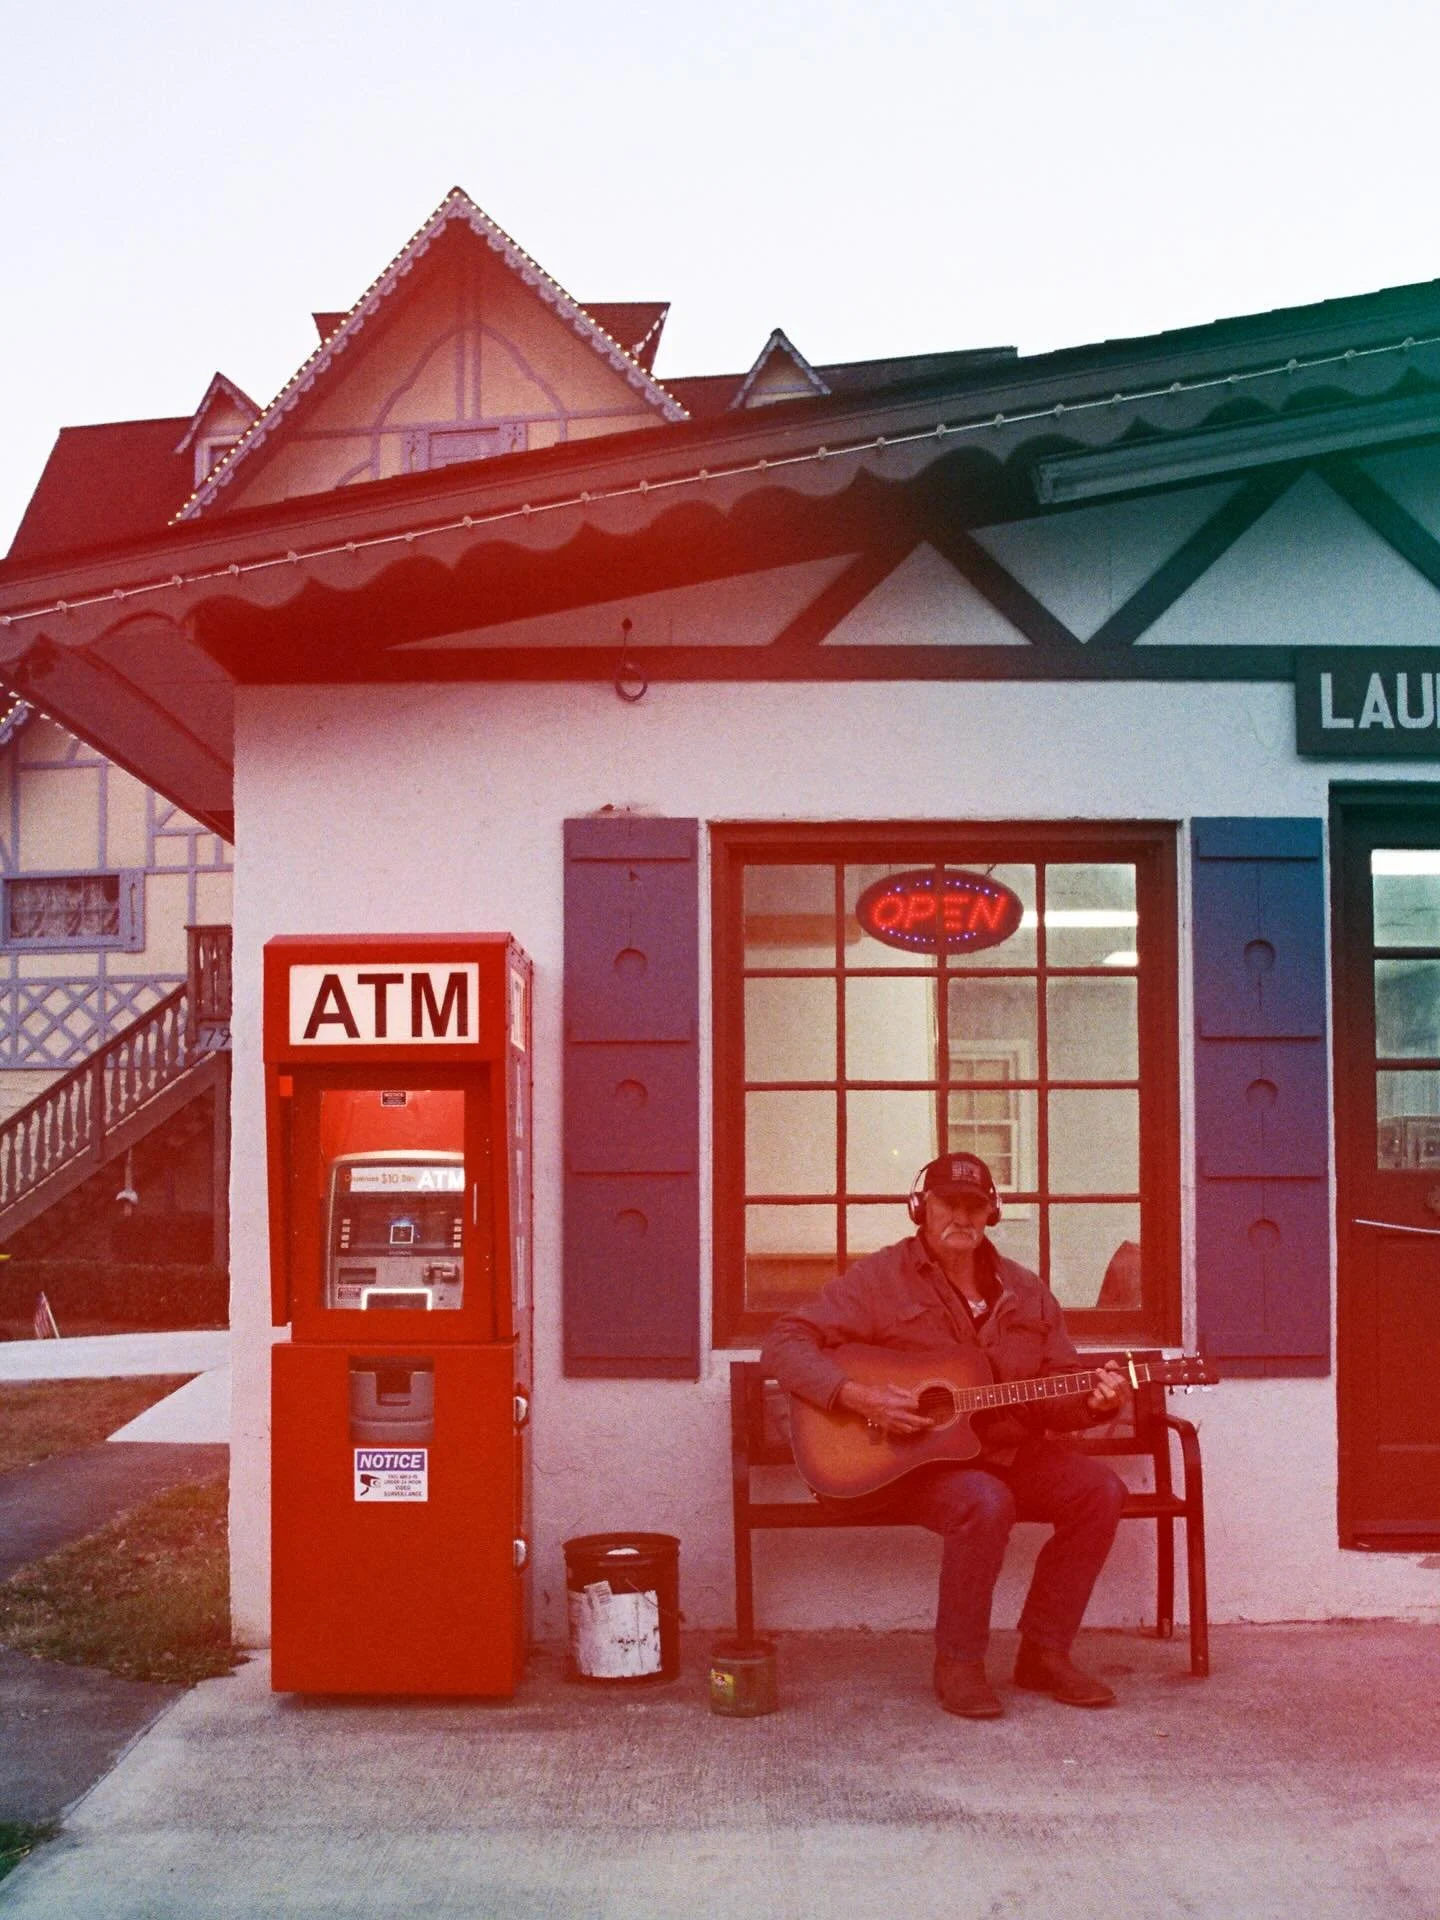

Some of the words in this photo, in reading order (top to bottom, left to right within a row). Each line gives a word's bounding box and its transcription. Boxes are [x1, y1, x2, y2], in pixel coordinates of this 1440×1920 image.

[1321, 672, 1440, 729] LAU
[872, 893, 1009, 931] OPEN
[303, 972, 468, 1039] ATM
[417, 1169, 465, 1189] ATM
[360, 1454, 422, 1468] NOTICE
